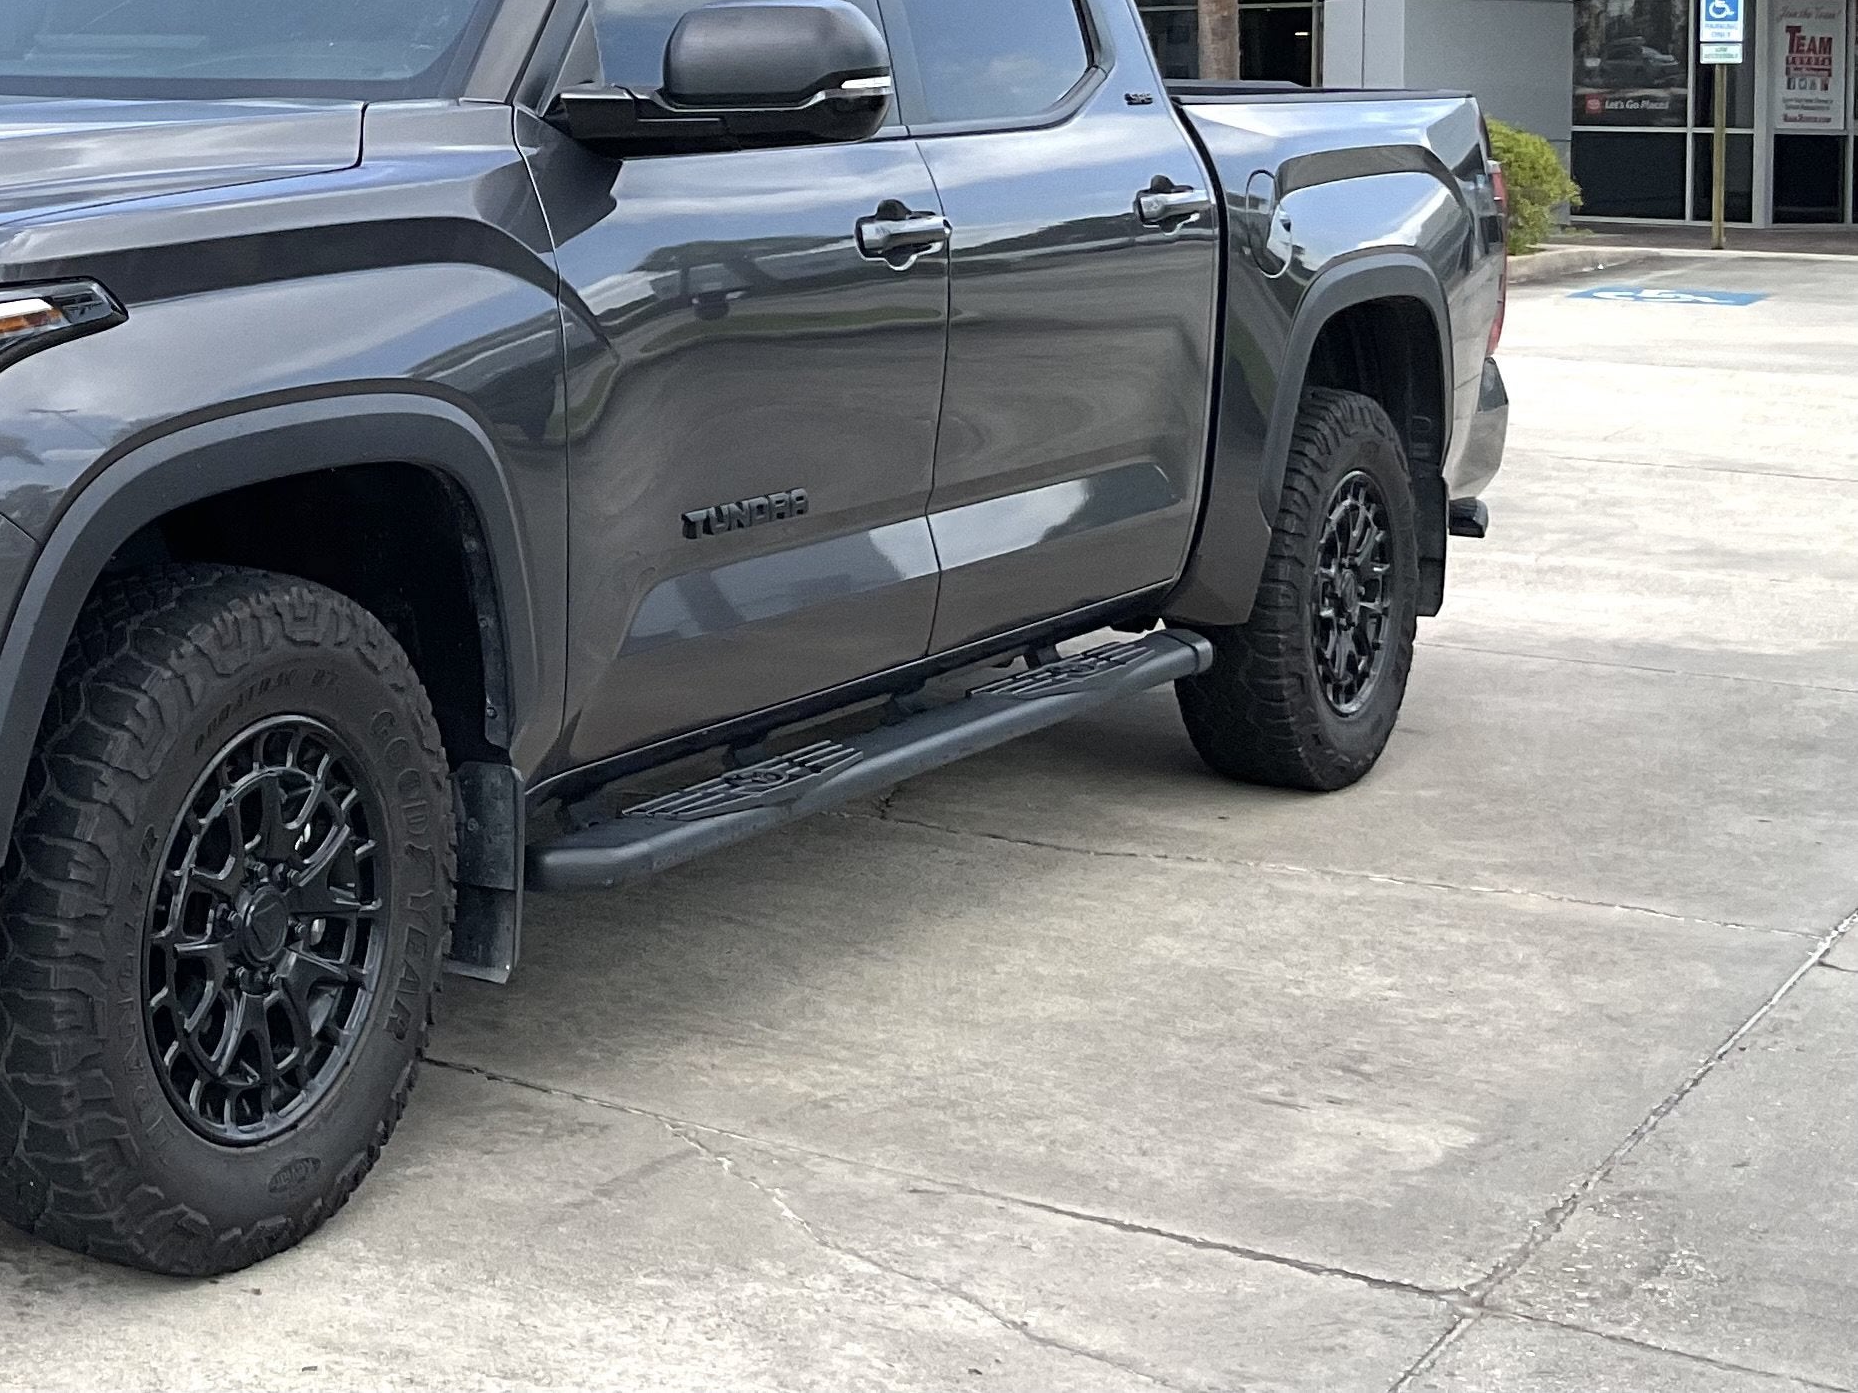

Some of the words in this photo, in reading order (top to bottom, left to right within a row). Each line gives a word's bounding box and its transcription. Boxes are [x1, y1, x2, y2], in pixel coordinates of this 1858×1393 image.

[1785, 25, 1833, 54] TEAM
[681, 485, 809, 539] TUNDRA
[370, 709, 435, 1042] GOODYEAR
